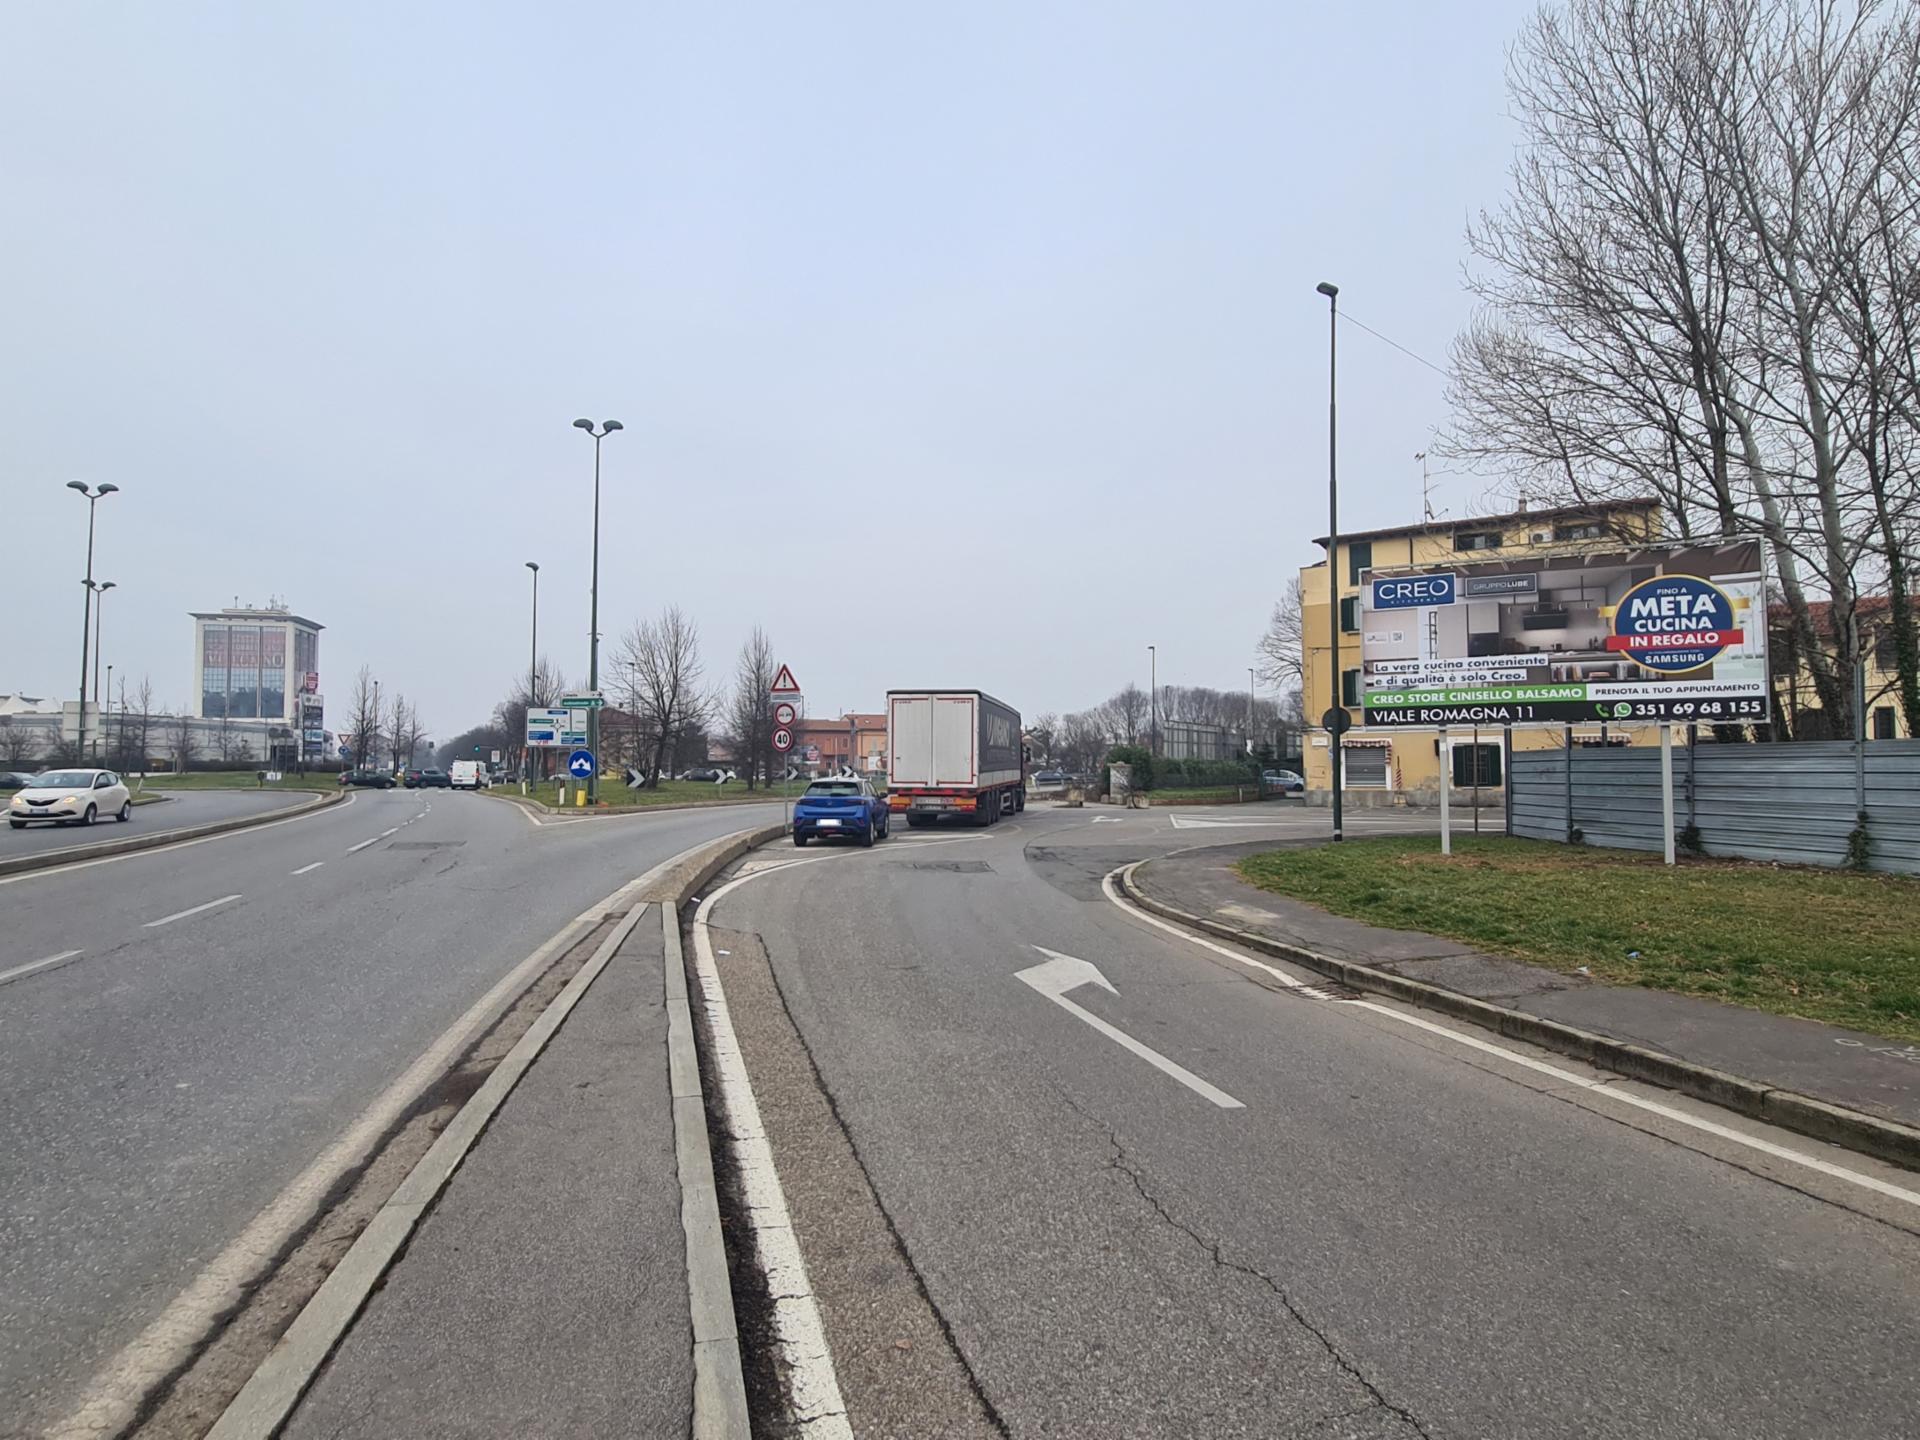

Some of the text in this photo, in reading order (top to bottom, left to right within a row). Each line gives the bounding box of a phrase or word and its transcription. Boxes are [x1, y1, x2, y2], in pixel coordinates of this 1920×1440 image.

[1378, 580, 1449, 599] CREO
[1634, 616, 1713, 632] CUCINA
[1629, 632, 1720, 648] IN REGALO
[1375, 656, 1547, 673] La vera cucina conveniente
[1644, 653, 1705, 664] SAMSUNG
[1386, 675, 1398, 685] di
[1401, 673, 1445, 687] qualità
[1461, 671, 1487, 681] solo
[1491, 670, 1526, 680] Creo.
[1372, 688, 1583, 705] CREO STORE CINISELLO BALSAMO
[1595, 683, 1760, 696] PRENOTA IL TUO APPUNTAMENTO
[1372, 705, 1534, 723] VIALE ROMAGNA 11
[1635, 700, 1761, 715] 351 69 68 155
[776, 733, 788, 745] 40
